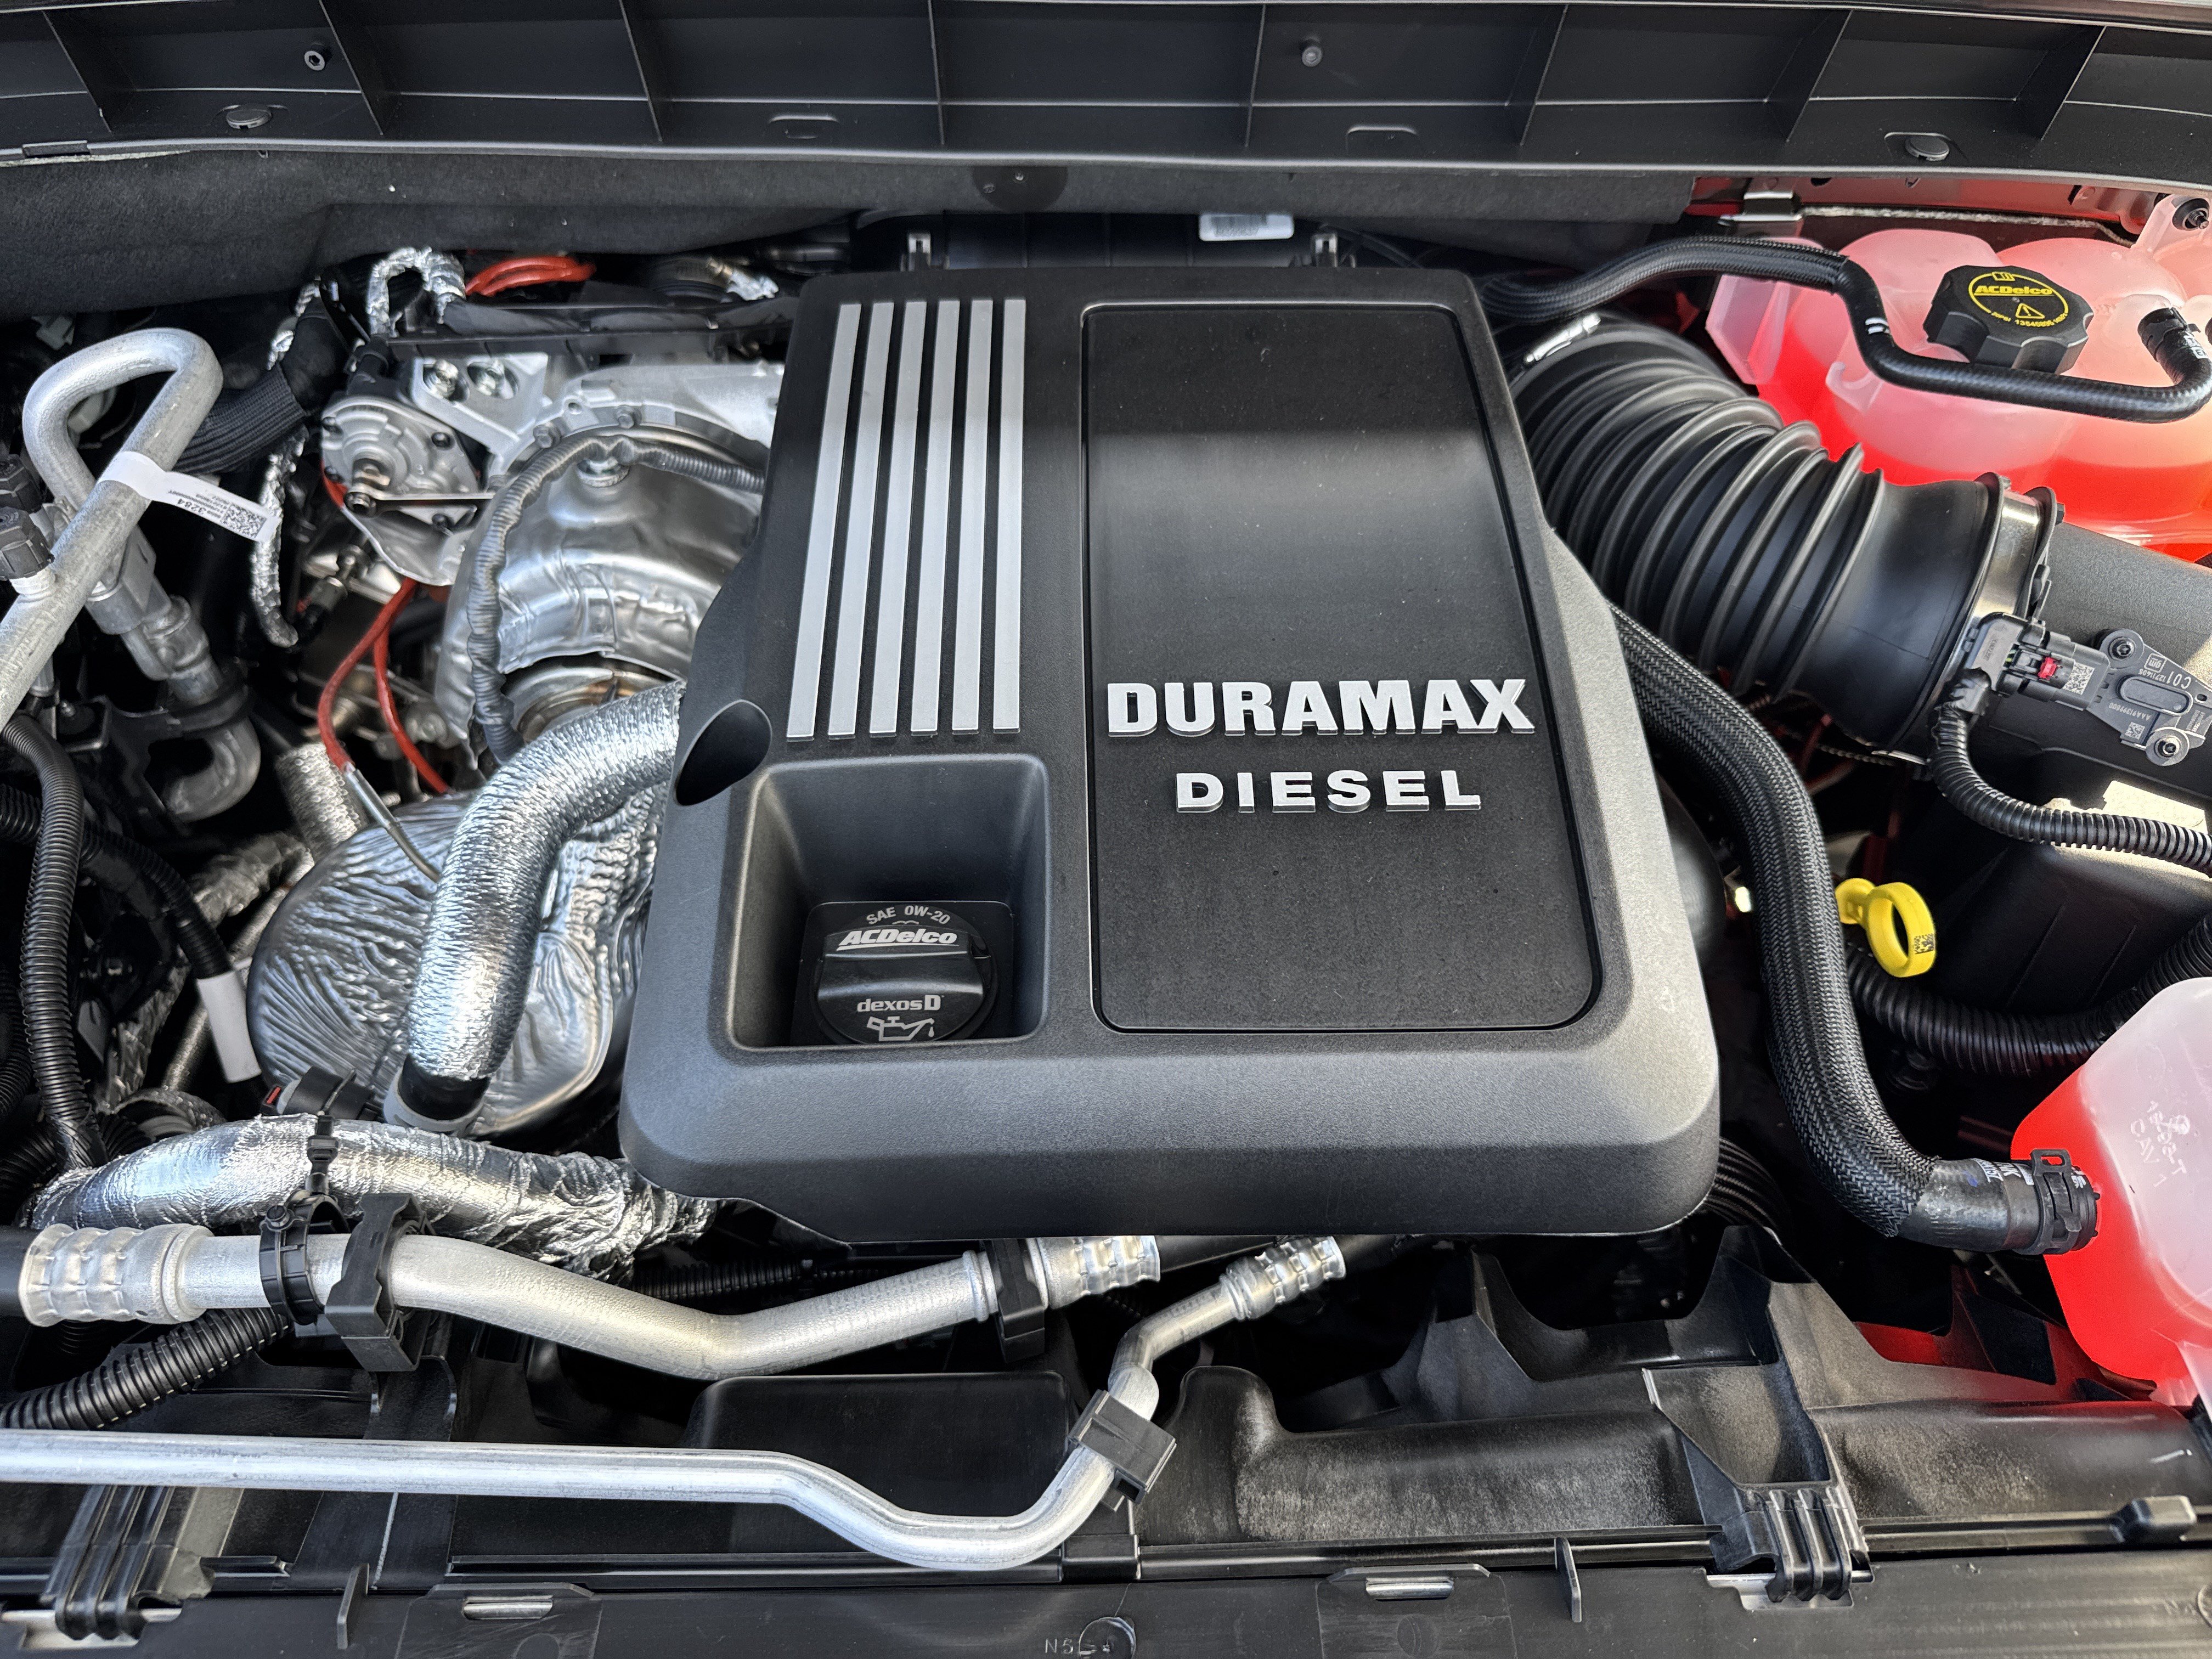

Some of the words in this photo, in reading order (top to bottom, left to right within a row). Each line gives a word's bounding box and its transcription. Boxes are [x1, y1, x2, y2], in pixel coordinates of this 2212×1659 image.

[1975, 285, 2052, 295] ACDelco
[2147, 656, 2160, 668] gm
[1107, 679, 1535, 737] DURAMAX
[1176, 771, 1481, 814] DIESEL
[866, 906, 896, 925] SAE
[904, 905, 951, 925] 0W-20
[838, 928, 958, 946] ACDelco
